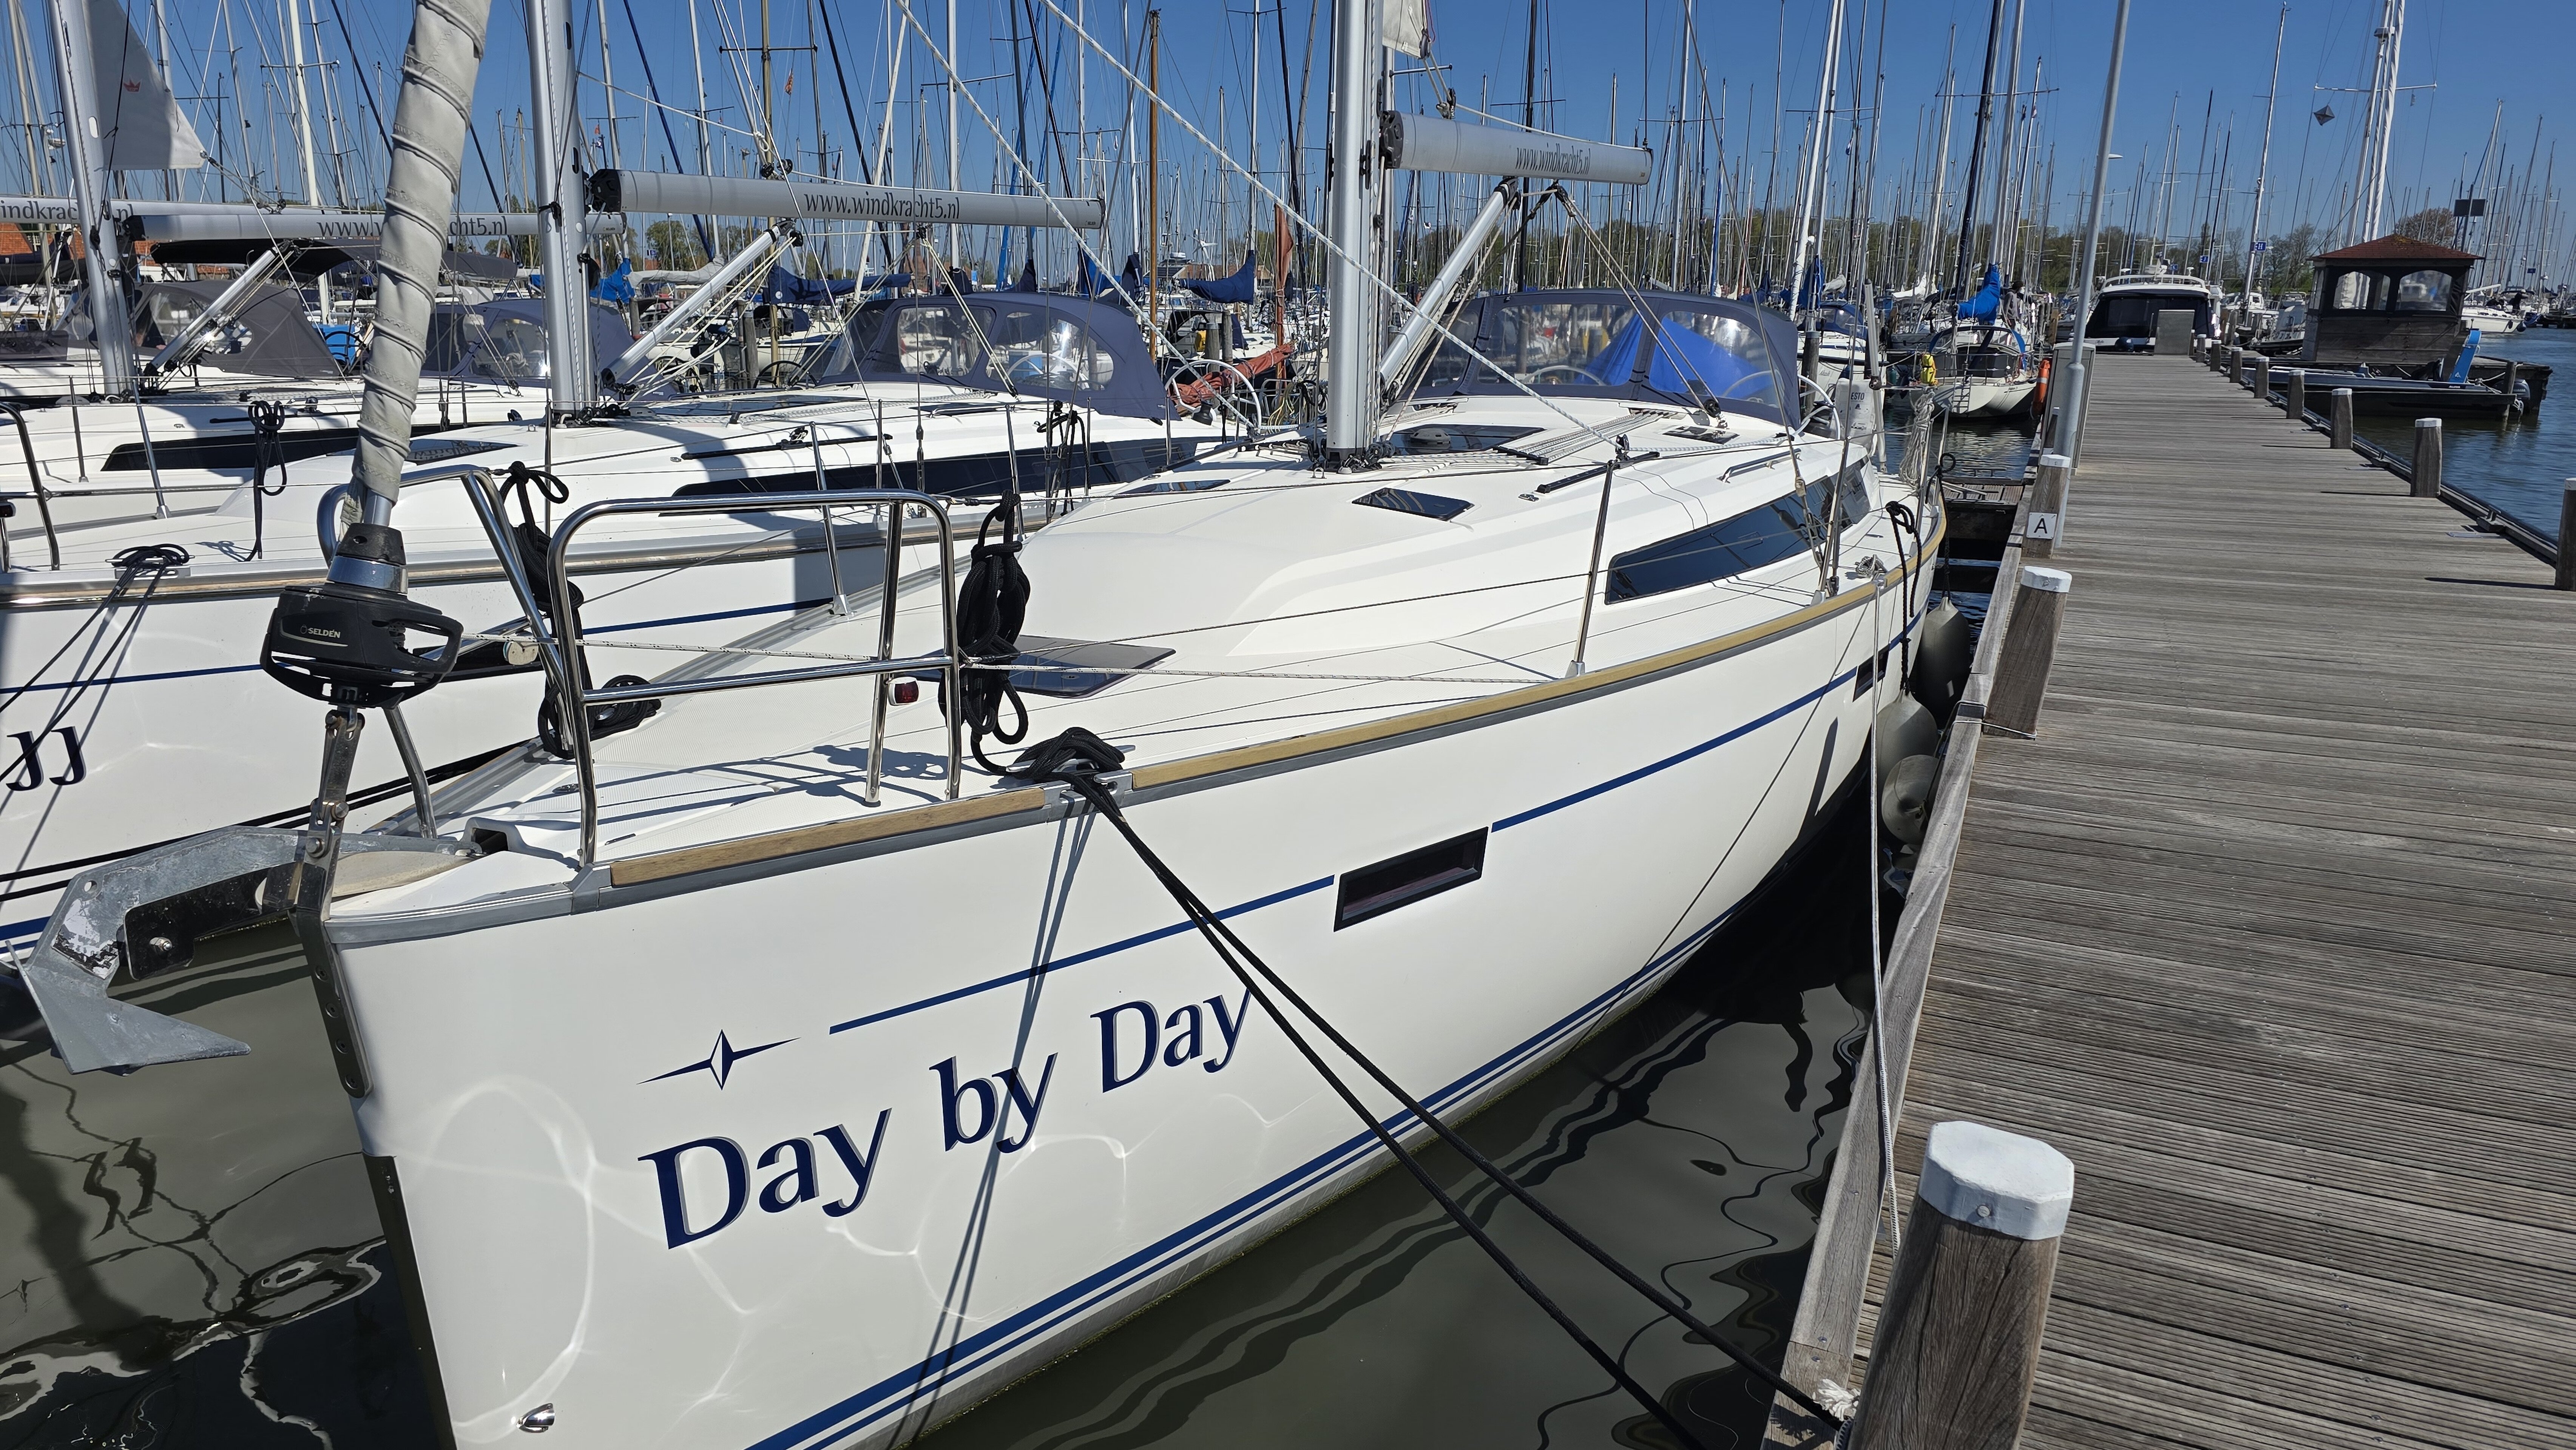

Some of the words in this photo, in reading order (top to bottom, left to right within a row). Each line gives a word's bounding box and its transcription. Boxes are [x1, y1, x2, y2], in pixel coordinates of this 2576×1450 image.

[1515, 142, 1591, 175] www.windkracht5.nl
[804, 191, 959, 219] www.windkracht5.nl
[2033, 518, 2048, 534] A
[307, 627, 341, 639] SELDÉN
[638, 1107, 892, 1250] Day
[929, 1052, 1059, 1154] by
[1090, 987, 1252, 1094] Day
